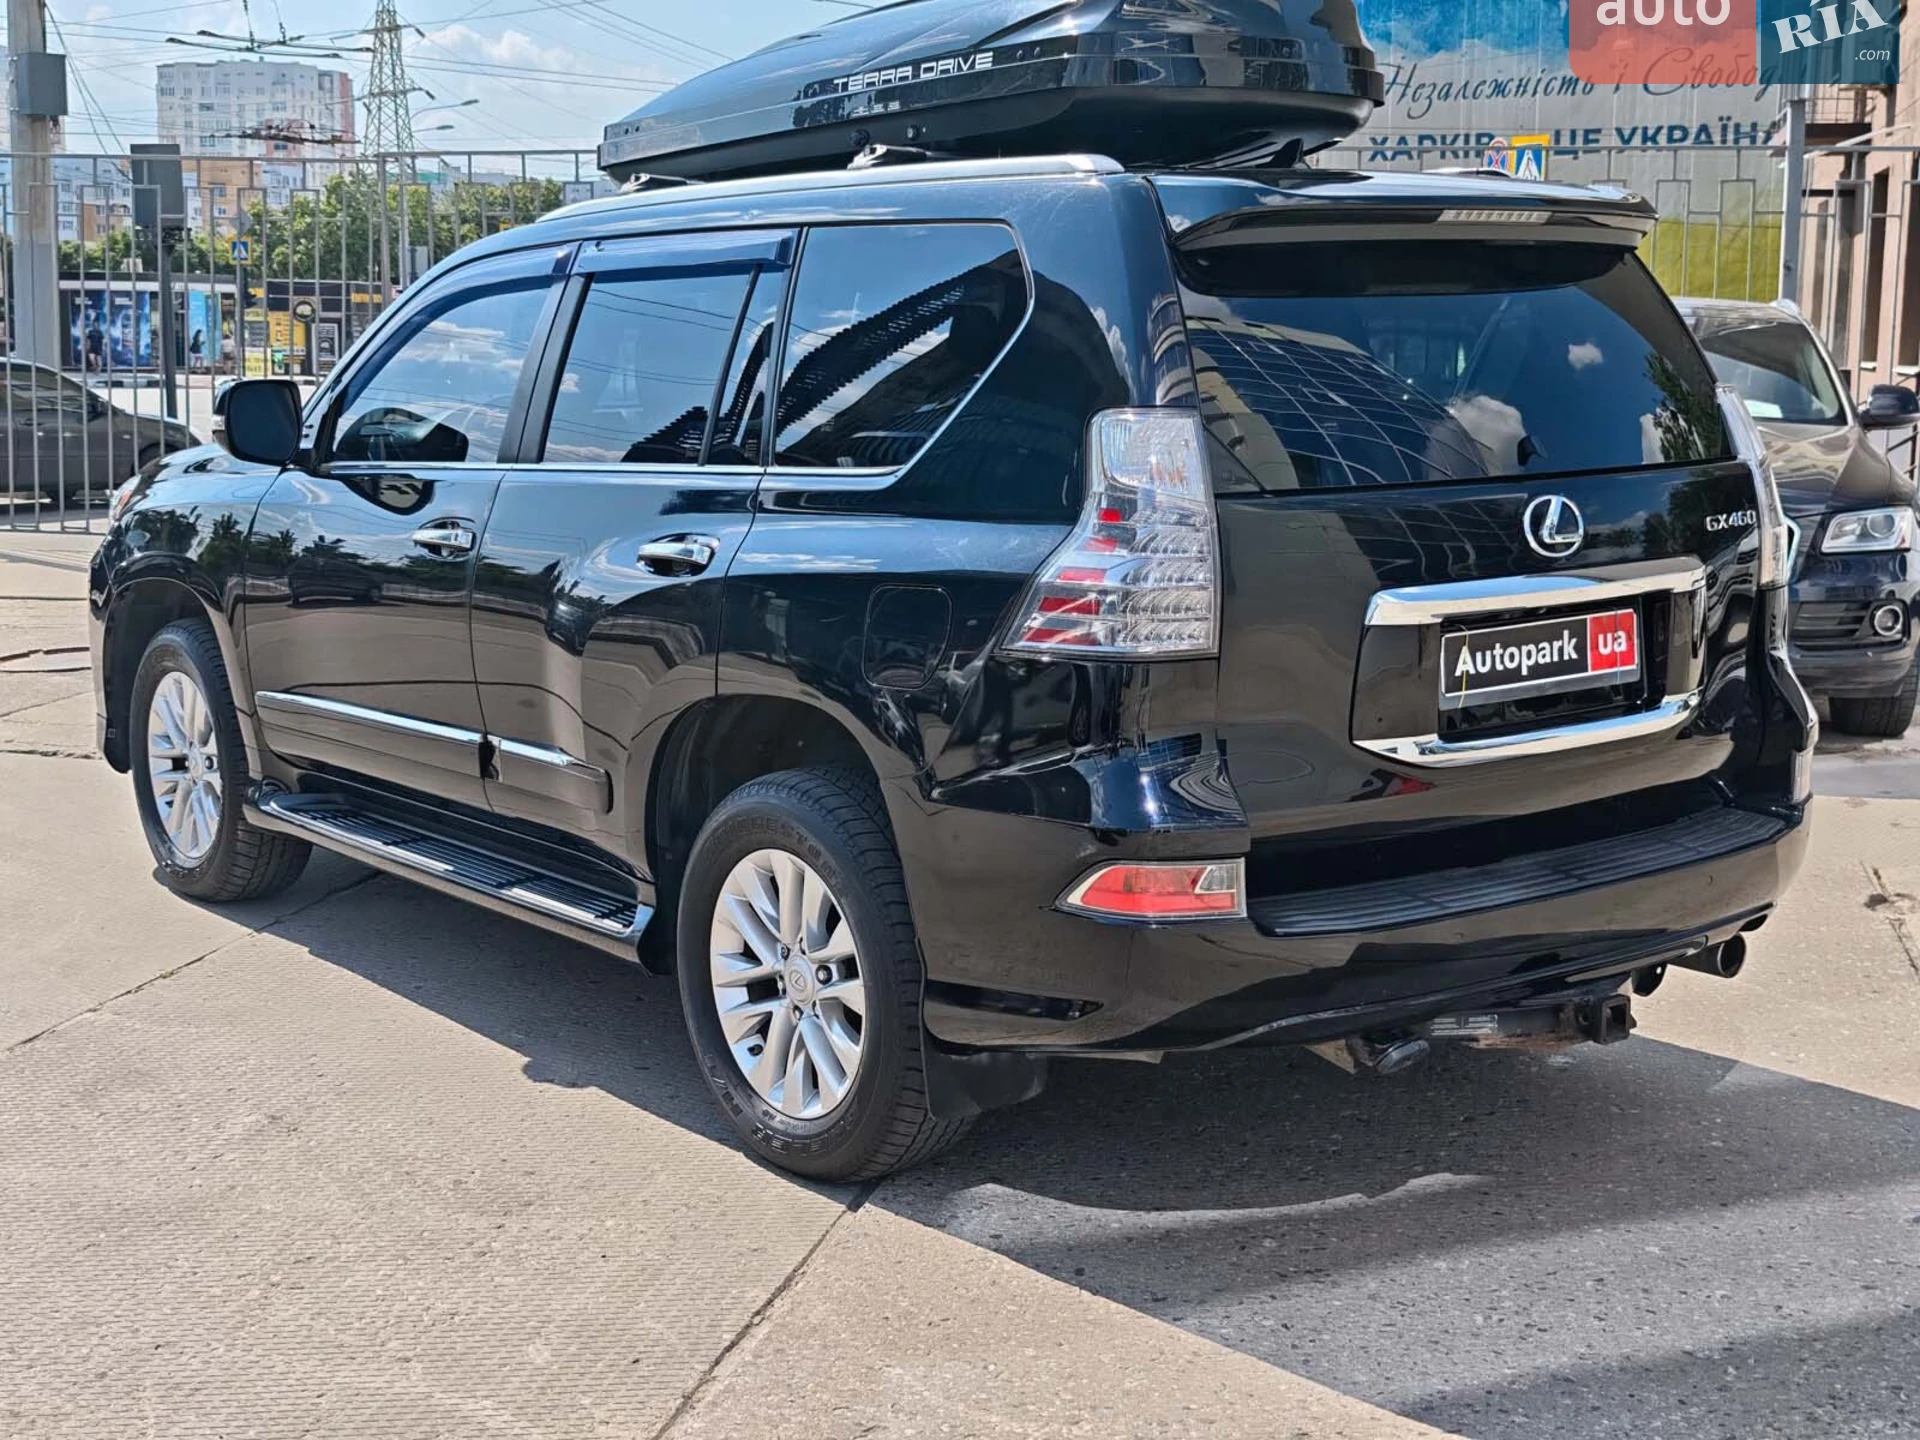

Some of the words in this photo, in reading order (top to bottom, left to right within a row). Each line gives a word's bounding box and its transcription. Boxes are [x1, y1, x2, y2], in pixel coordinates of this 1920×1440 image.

[833, 65, 913, 93] TERRA
[919, 51, 994, 79] DRIVE
[1377, 62, 1596, 120] Незалежність
[1705, 510, 1757, 532] GX460
[1454, 629, 1579, 677] Autopark
[1597, 630, 1628, 656] ua
